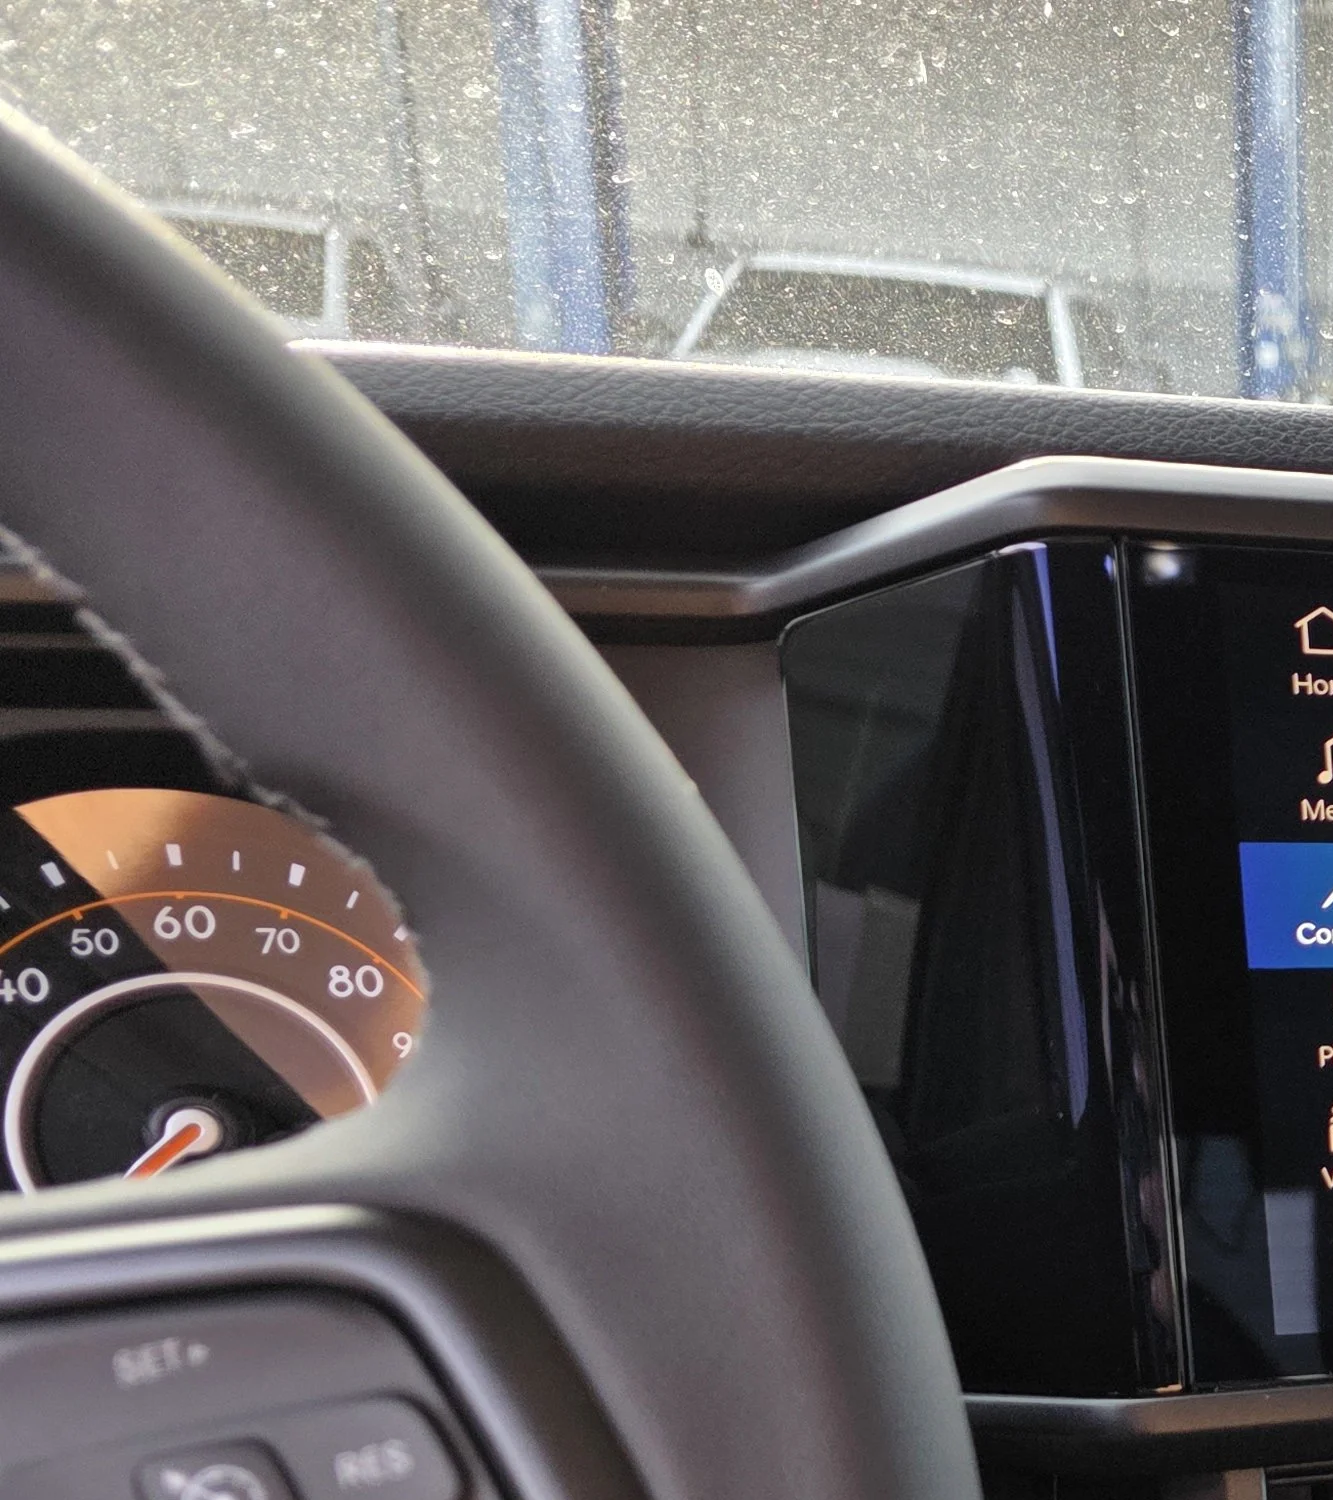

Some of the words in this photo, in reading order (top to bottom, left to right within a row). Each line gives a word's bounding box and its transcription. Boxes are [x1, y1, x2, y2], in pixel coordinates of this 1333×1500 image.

[153, 905, 216, 940] 60
[71, 928, 120, 957] 50
[255, 927, 301, 955] 70
[328, 965, 384, 998] 80
[392, 1031, 414, 1059] 9
[335, 1439, 414, 1483] RES
